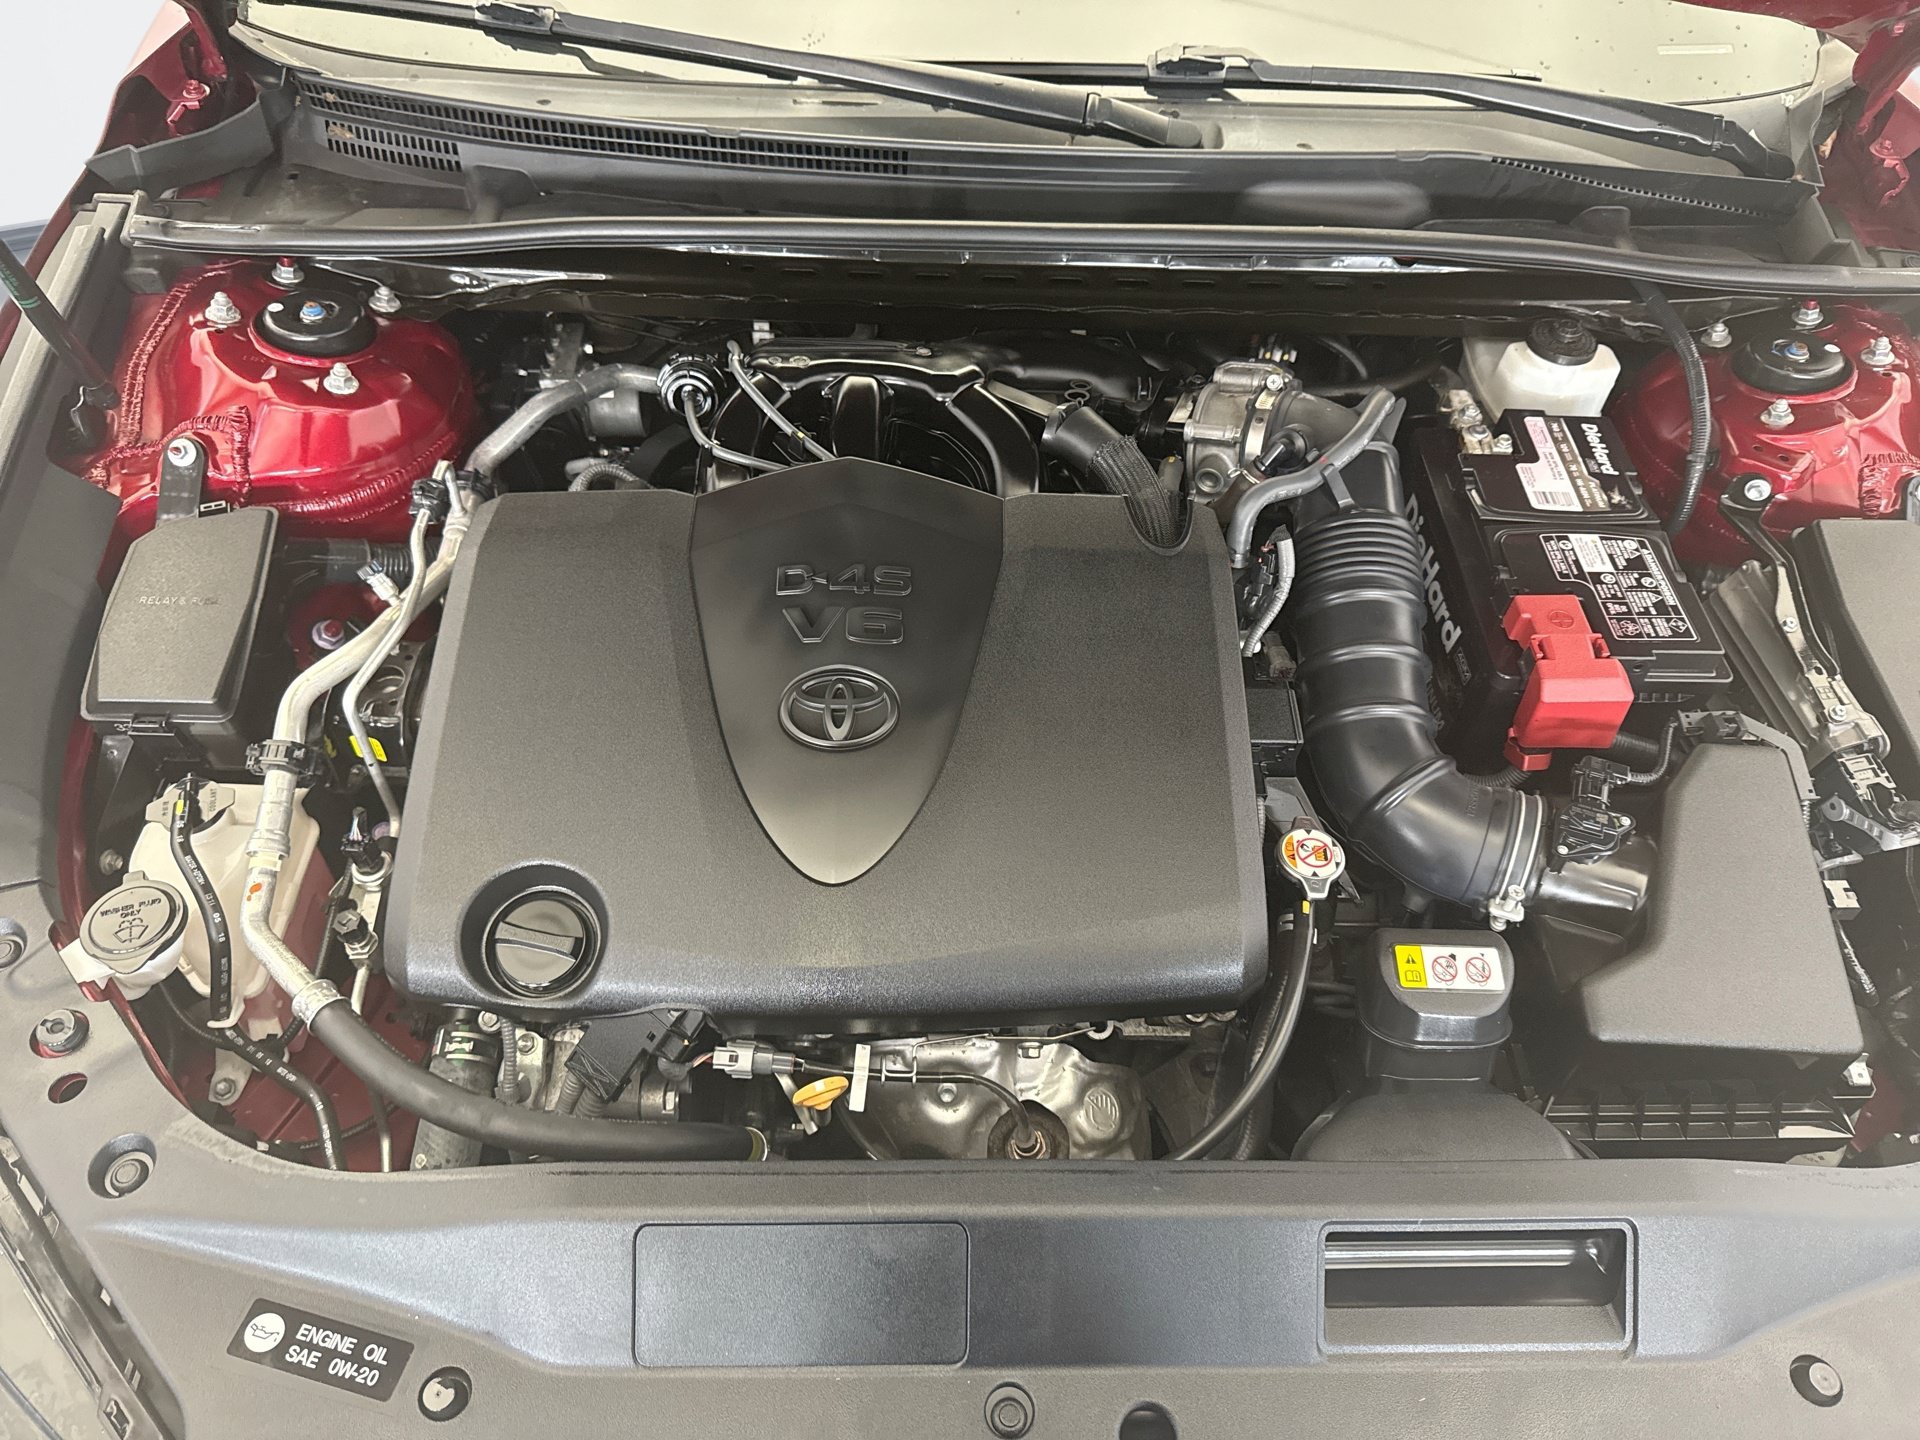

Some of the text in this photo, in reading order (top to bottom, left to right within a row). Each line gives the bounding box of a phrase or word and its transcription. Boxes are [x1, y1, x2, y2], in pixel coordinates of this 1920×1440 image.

[1581, 423, 1620, 475] DieHard
[776, 564, 912, 596] D-4S
[138, 595, 178, 605] RELAY
[782, 606, 904, 645] V6
[100, 904, 135, 917] WASHER
[120, 909, 142, 919] ONLY
[212, 912, 222, 923] 05
[218, 932, 226, 943] 18
[295, 1323, 389, 1366] ENGINE OIL
[285, 1345, 380, 1387] SAE 0W-20
